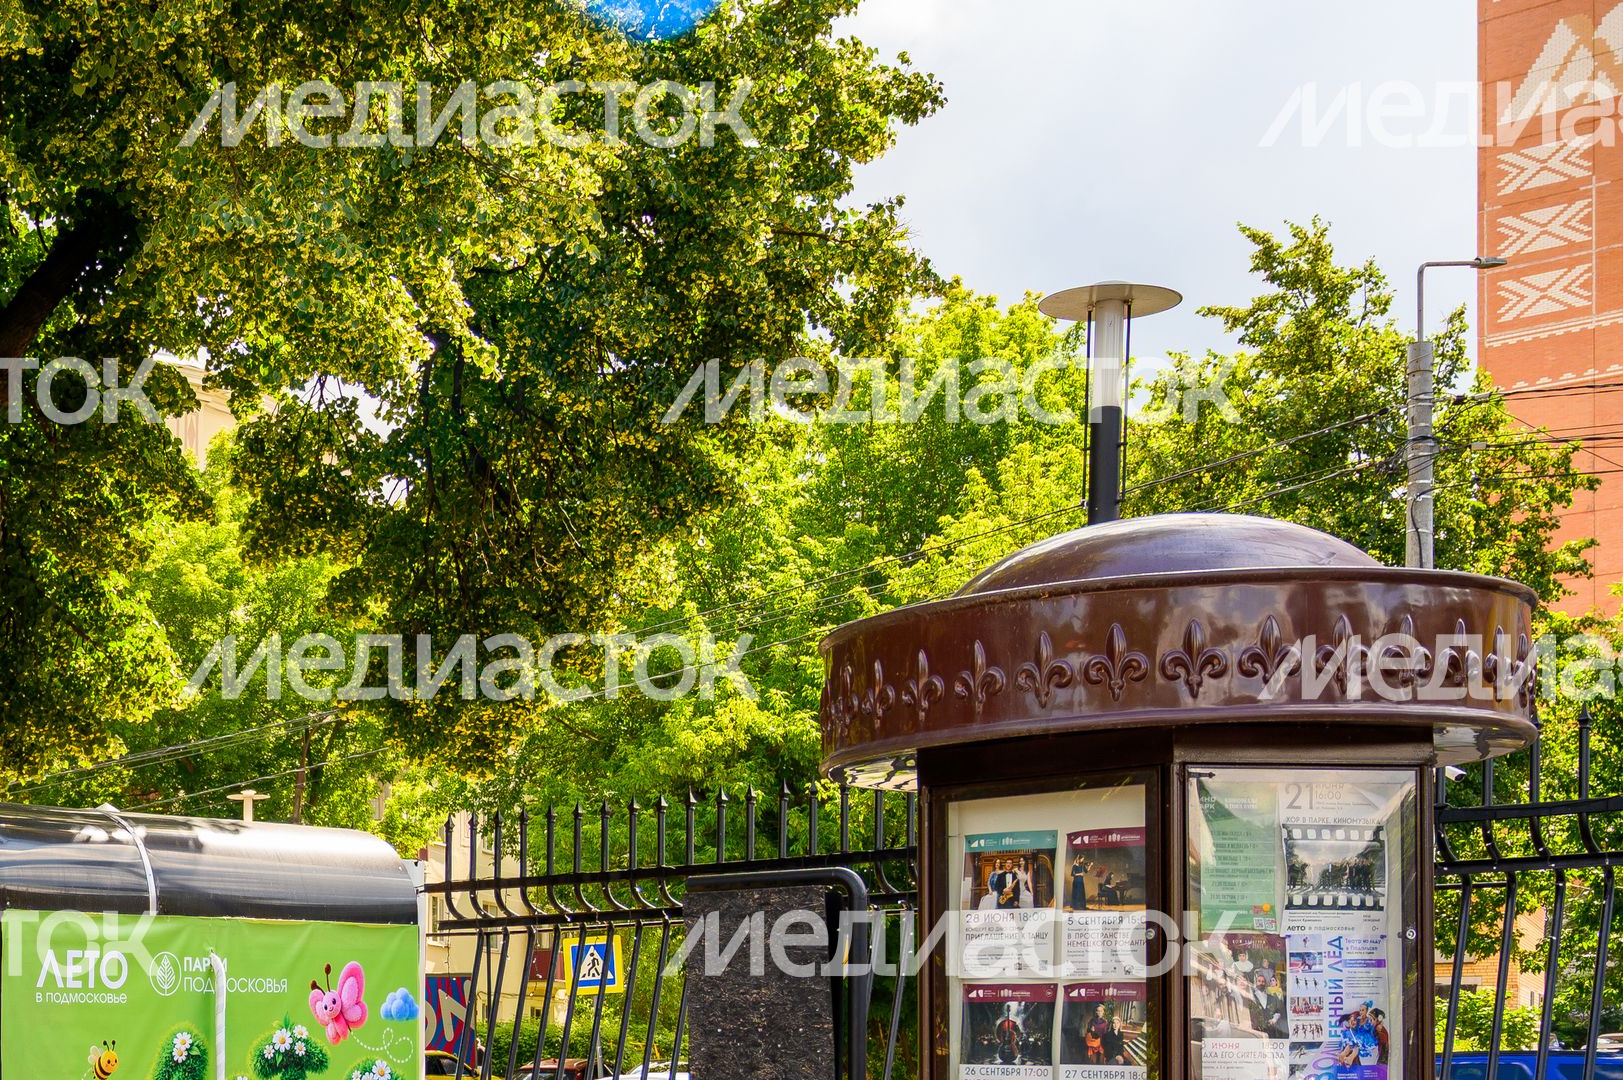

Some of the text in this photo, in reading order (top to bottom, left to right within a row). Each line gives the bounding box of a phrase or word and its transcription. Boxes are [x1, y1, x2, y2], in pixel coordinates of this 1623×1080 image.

[966, 914, 980, 924] 28
[984, 913, 1015, 922] ИЮНЯ
[36, 949, 128, 990] ЛЕТО
[184, 976, 288, 994] ПОДОСКОВЬЯ
[966, 1067, 1048, 1076] 26 СЕНТЯБРЯ 17:00
[1065, 1070, 1126, 1080] 27 СЕНТЯБРЯ
